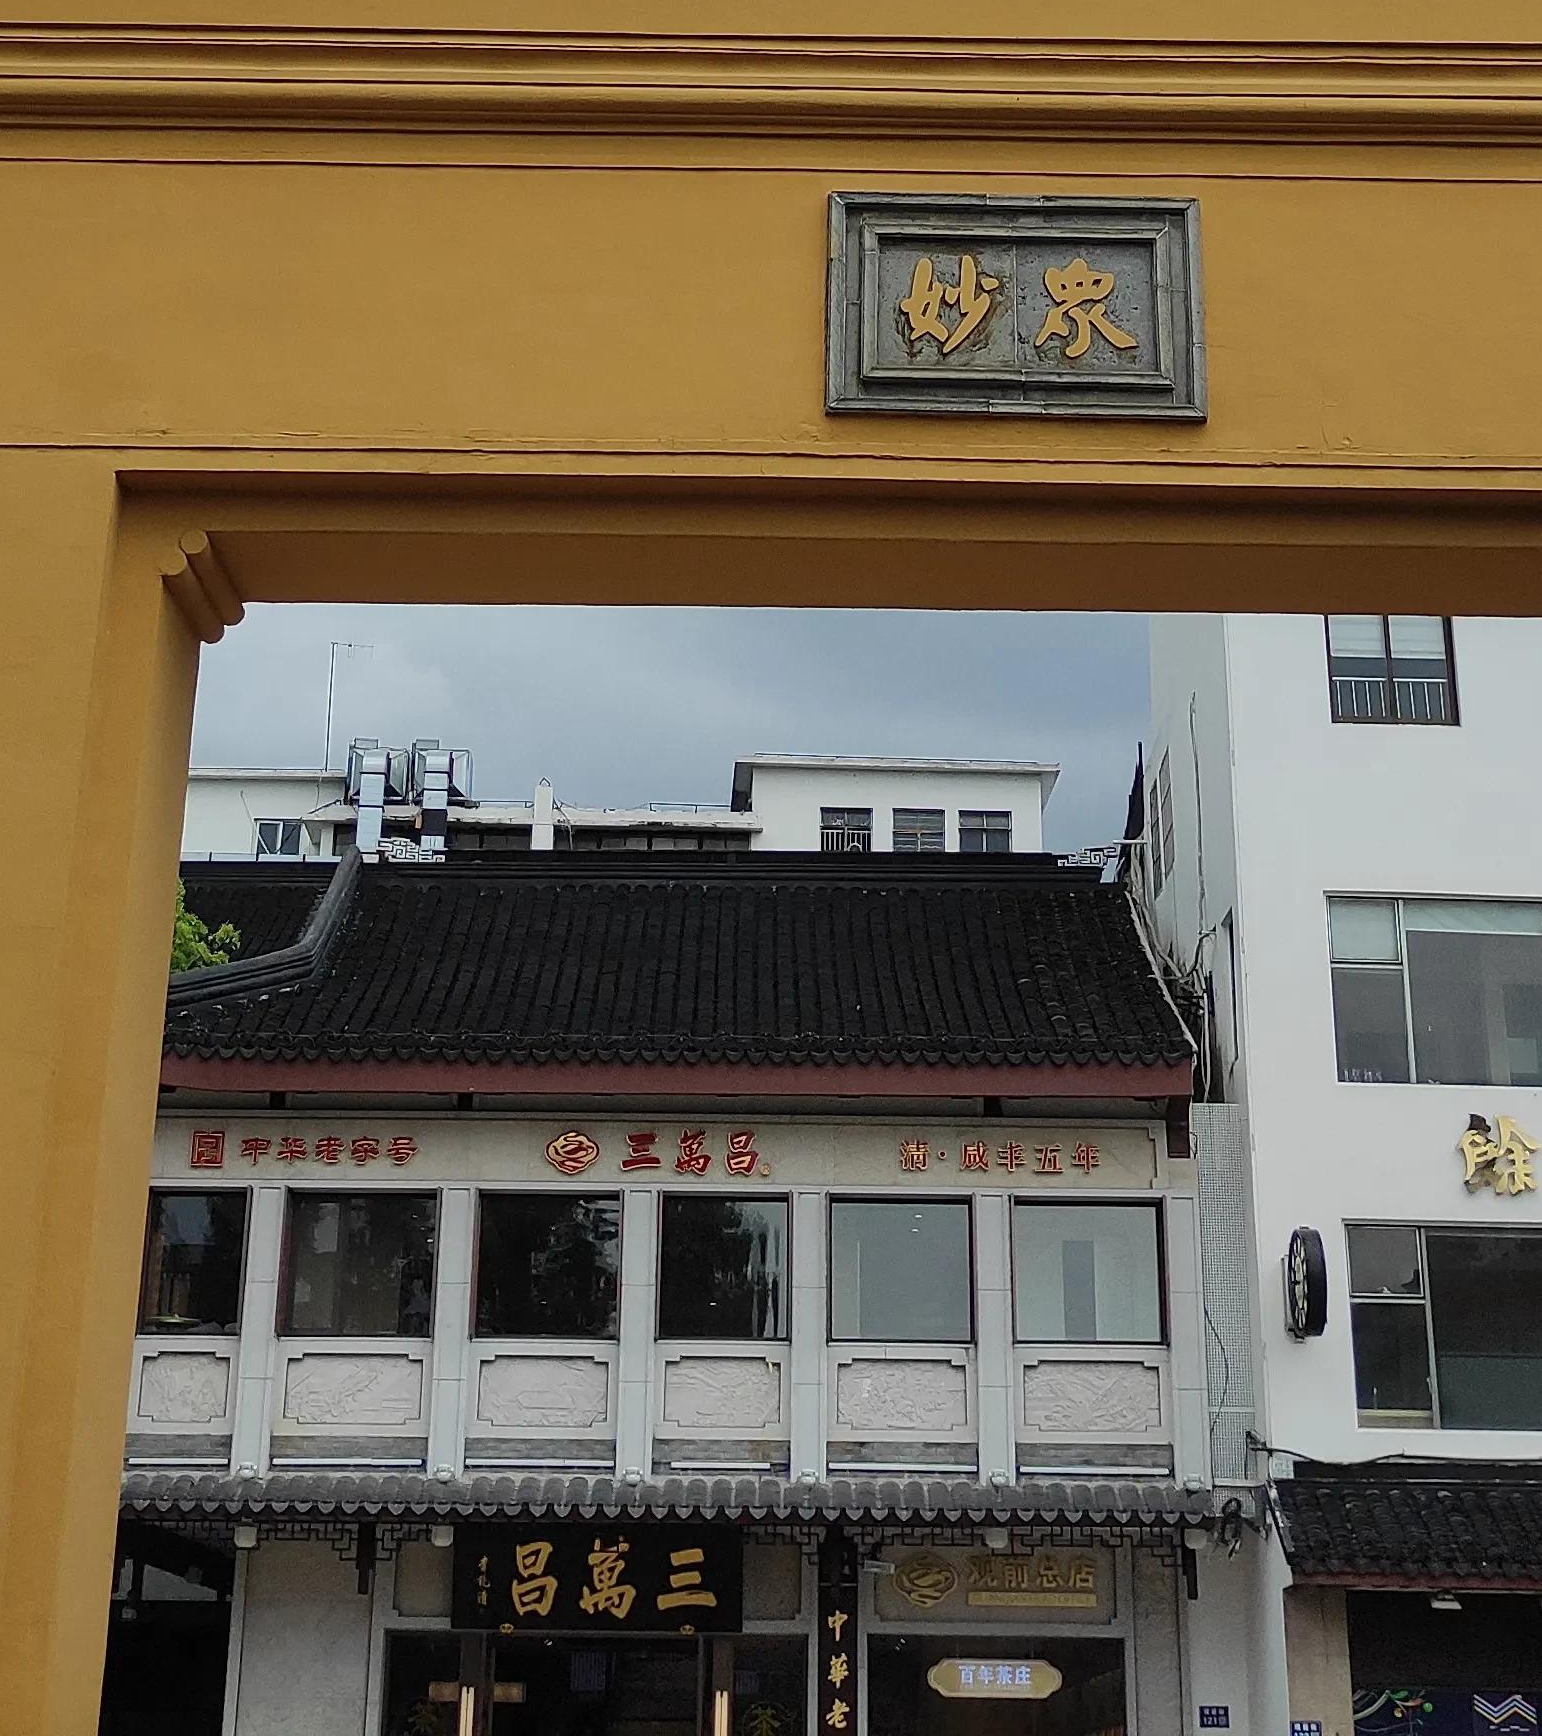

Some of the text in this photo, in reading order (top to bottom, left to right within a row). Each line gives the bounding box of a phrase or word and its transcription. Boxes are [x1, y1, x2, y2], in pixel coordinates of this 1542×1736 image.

[239, 1136, 419, 1165] 中华老字号
[619, 1128, 761, 1176] 三萬昌
